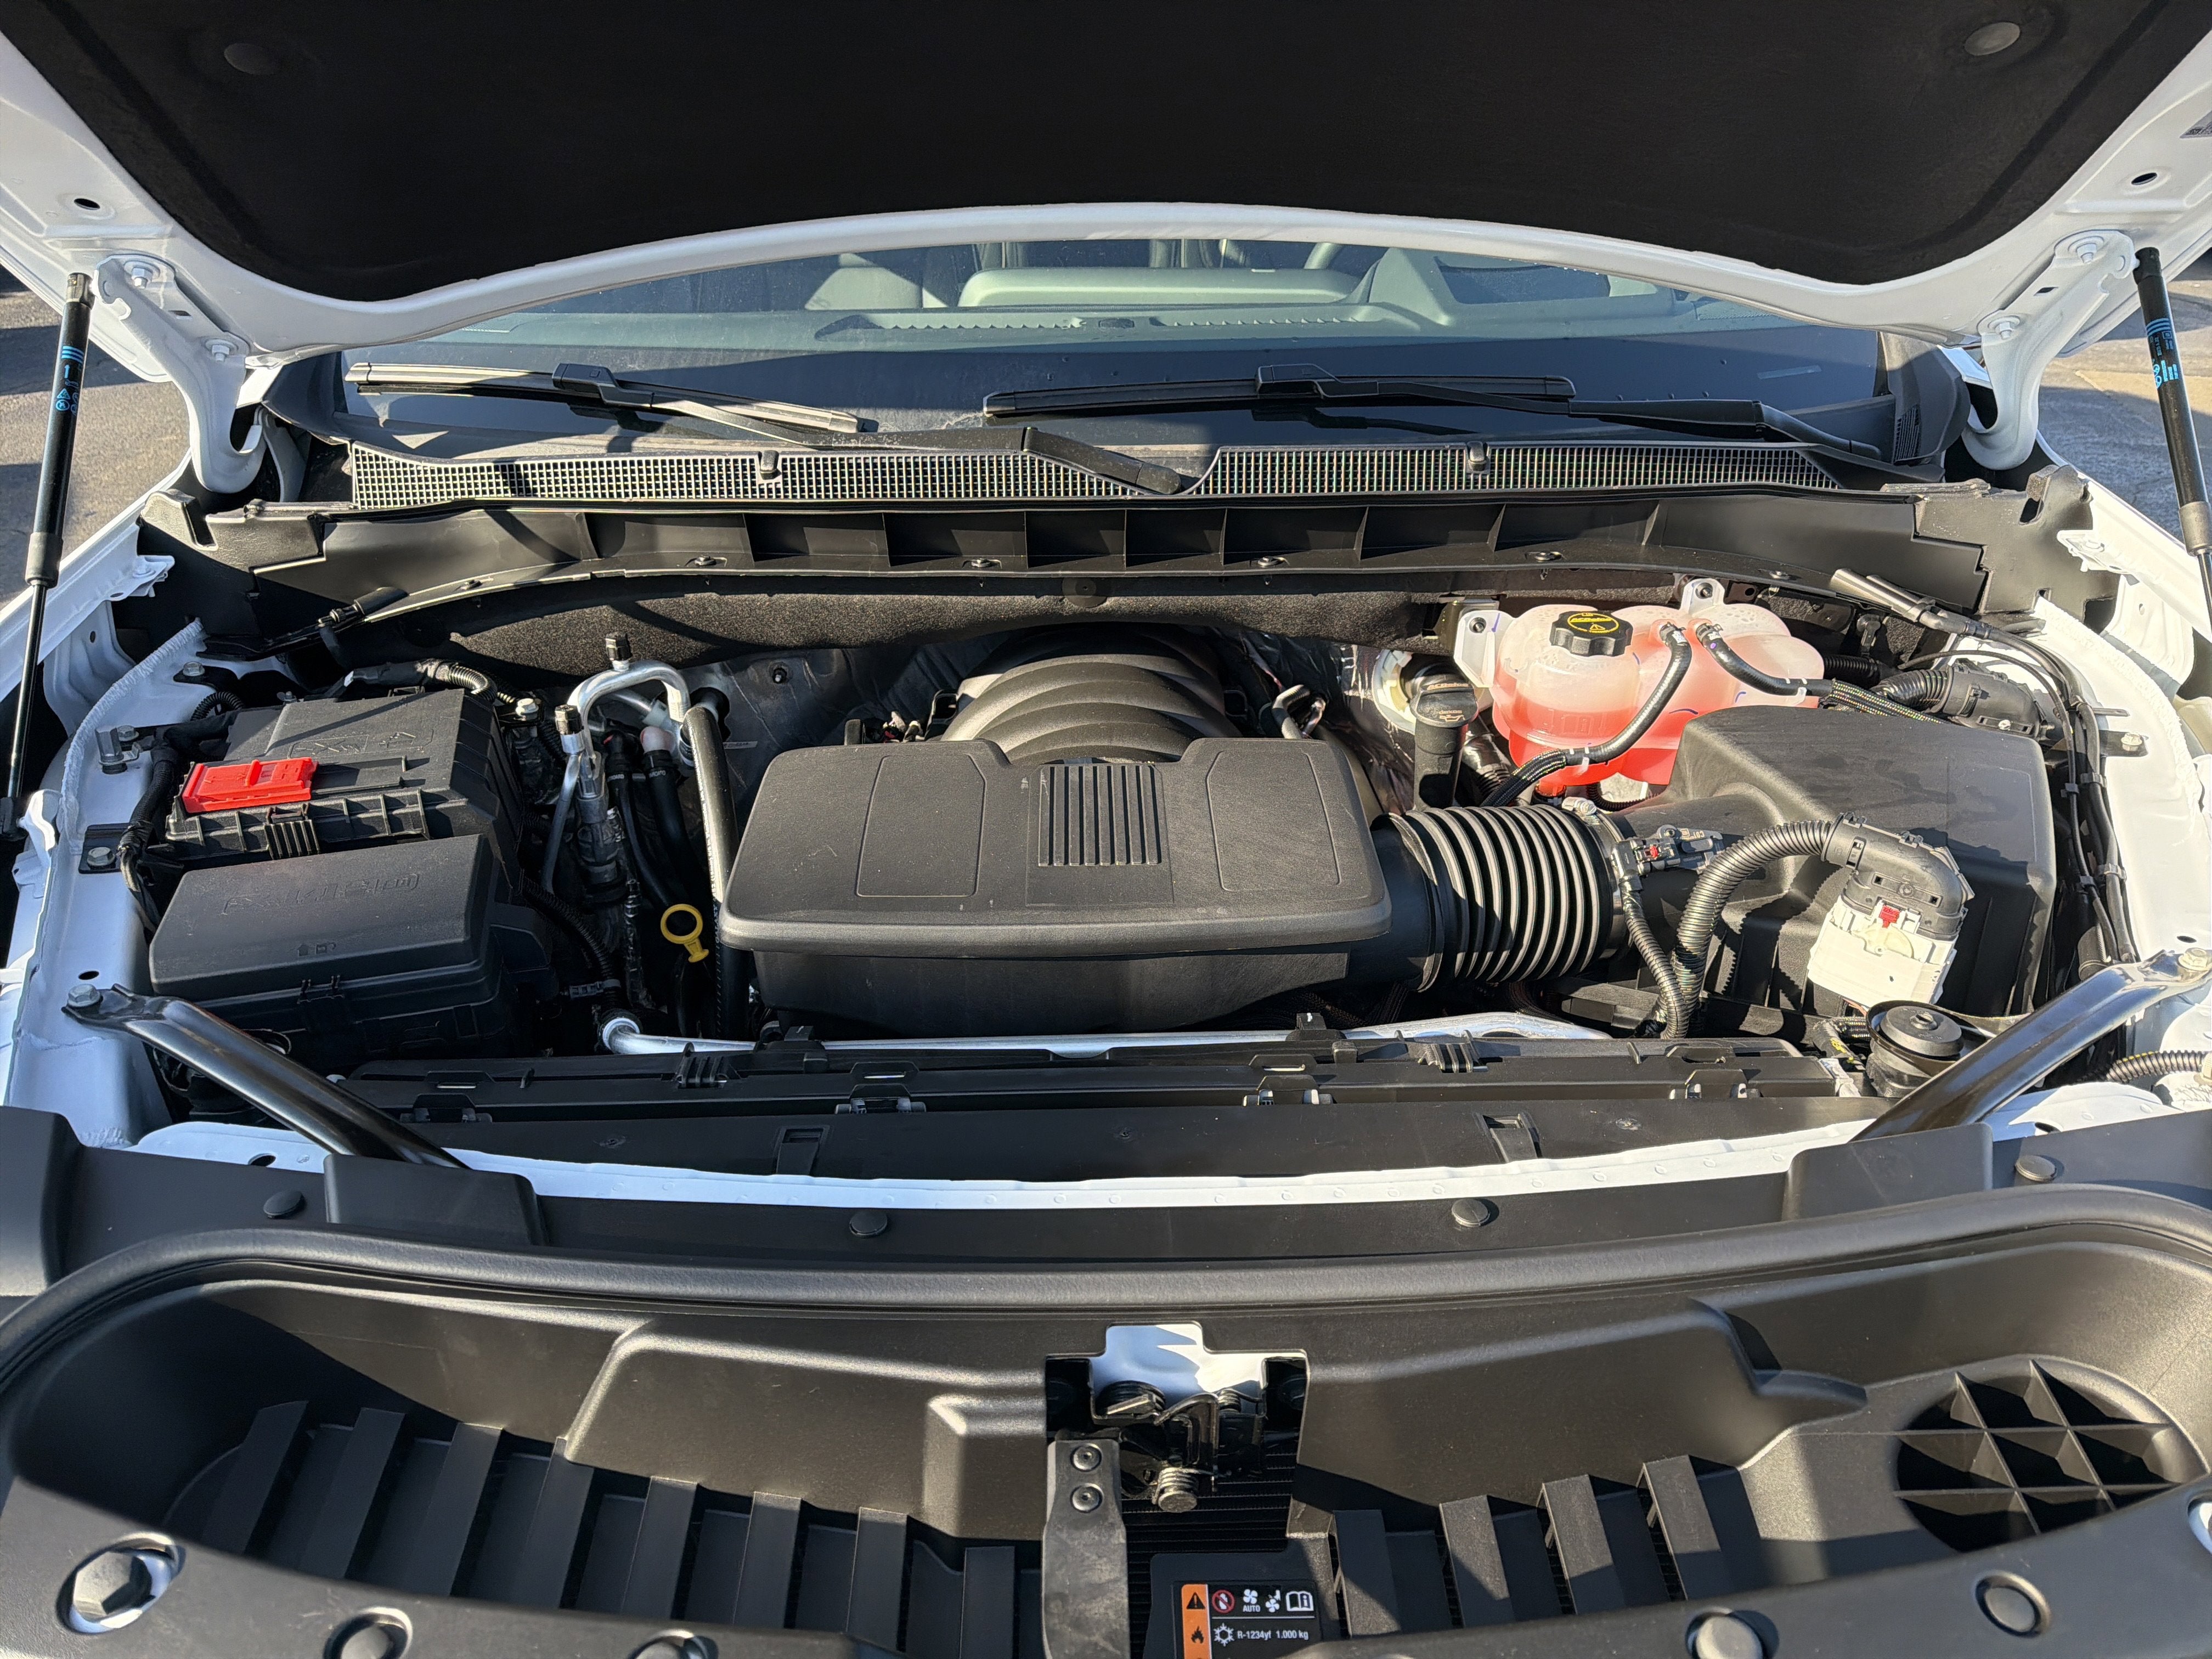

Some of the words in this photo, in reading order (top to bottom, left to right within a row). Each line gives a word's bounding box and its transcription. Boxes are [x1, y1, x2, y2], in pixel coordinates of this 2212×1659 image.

[1427, 682, 1469, 691] ACDelco
[1237, 1630, 1272, 1640] R-1234yf
[1276, 1630, 1297, 1639] 1.000
[1299, 1630, 1309, 1640] kg
